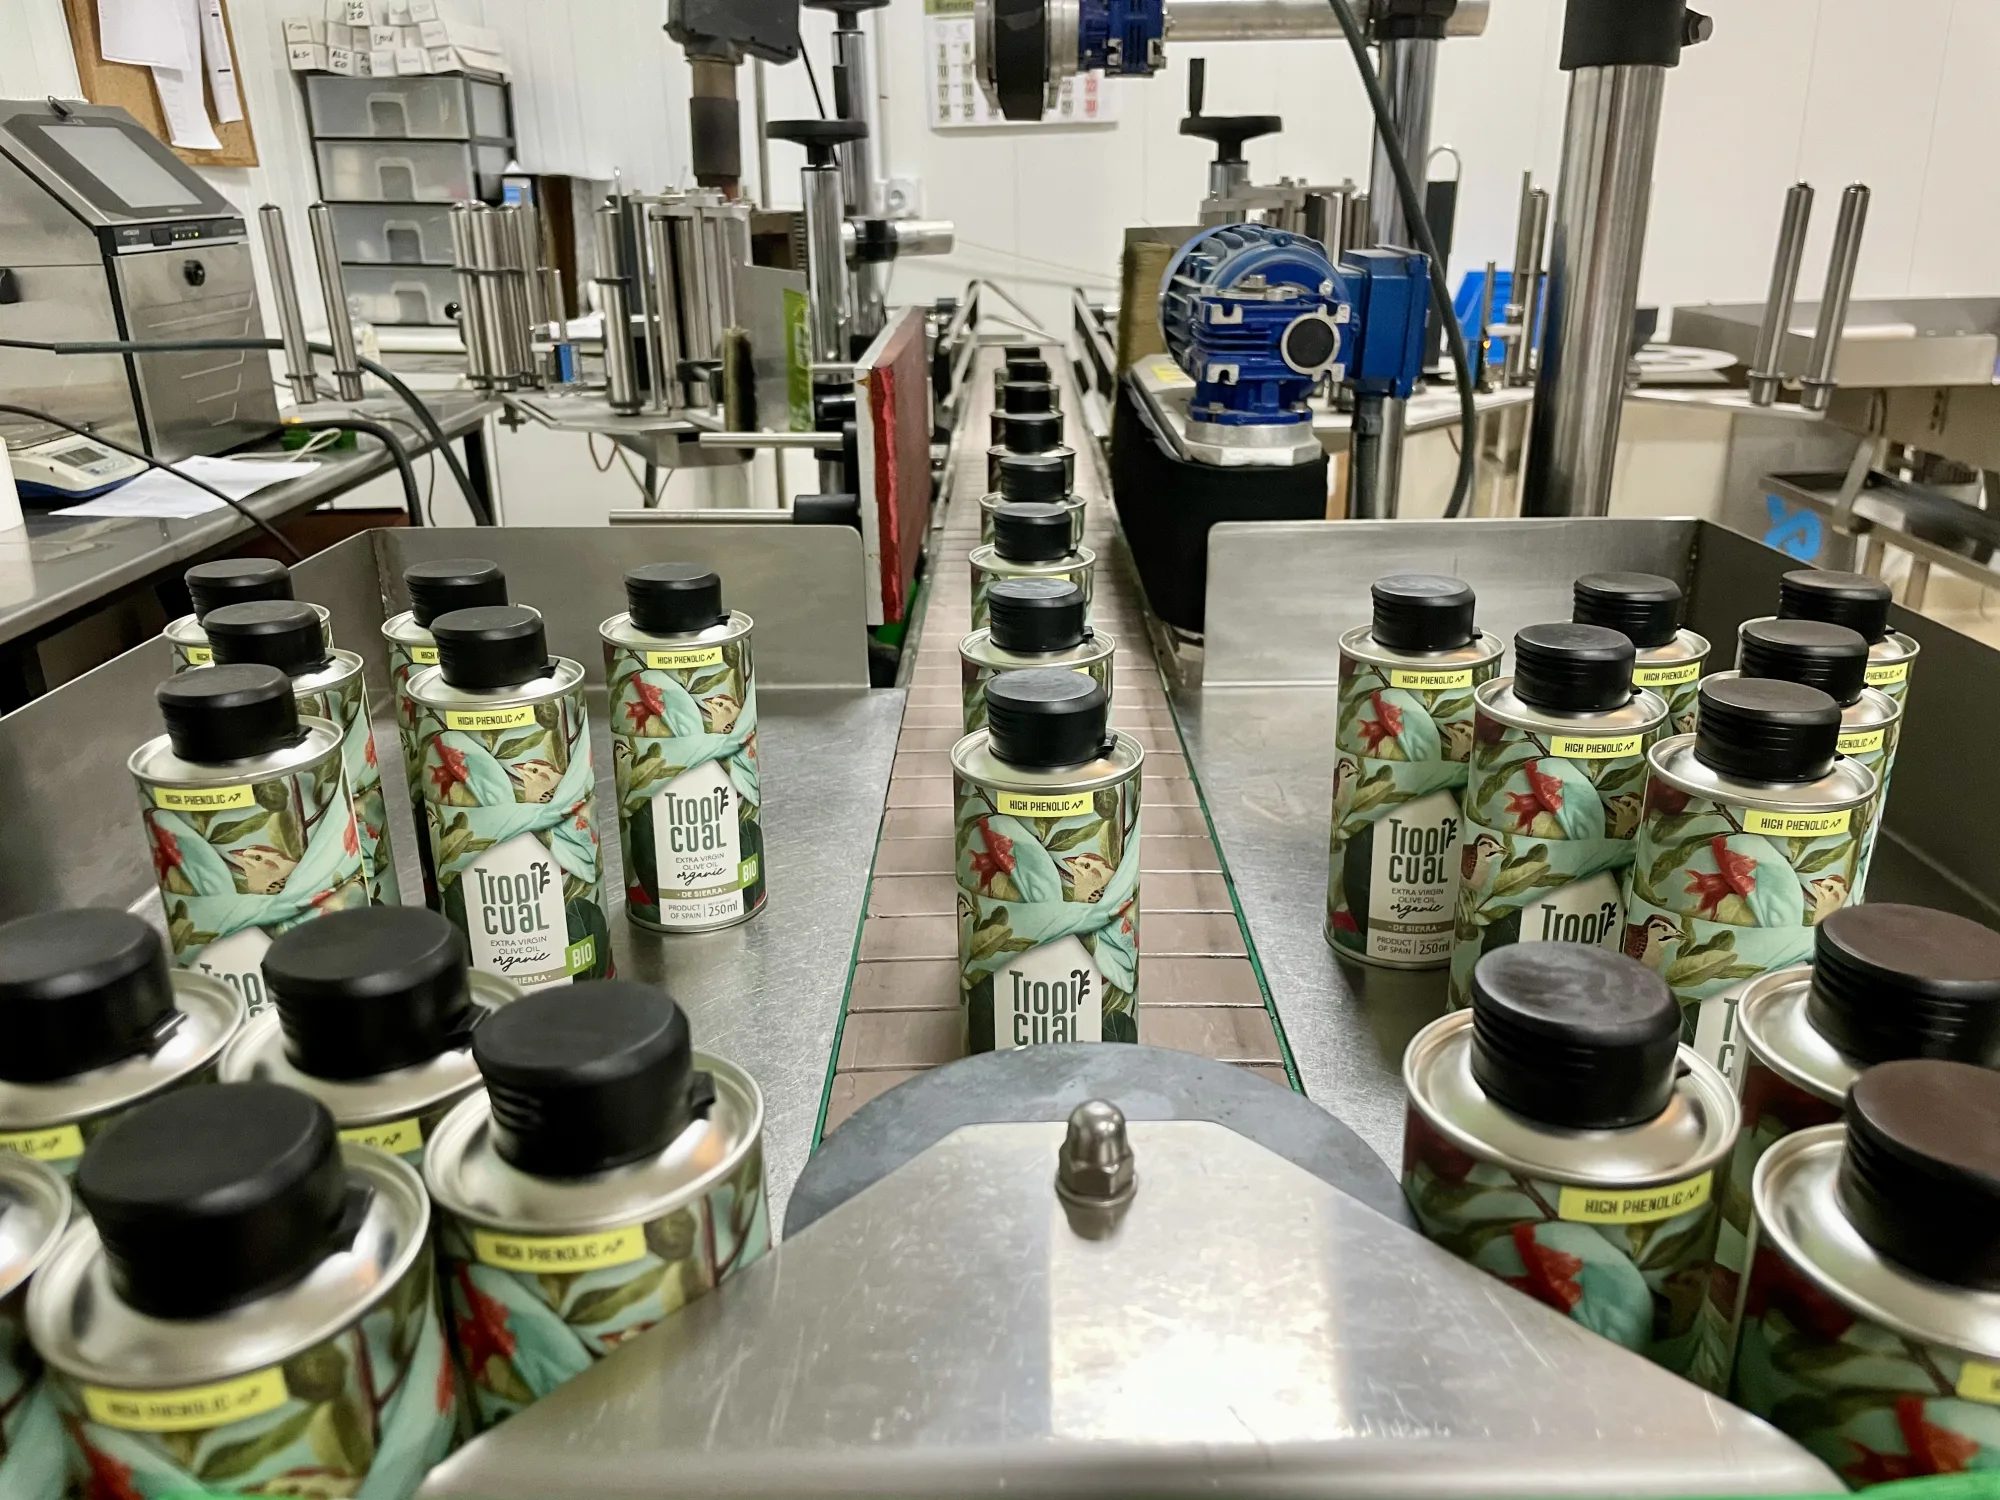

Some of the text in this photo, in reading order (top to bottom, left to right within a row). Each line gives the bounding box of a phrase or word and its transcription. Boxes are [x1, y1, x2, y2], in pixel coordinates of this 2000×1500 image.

[657, 654, 706, 665] HIGH PHENOLIC
[1402, 675, 1454, 685] HIGH PHENOLIC
[1643, 669, 1689, 682] HIGH PHENOLIC
[1865, 670, 1894, 681] PHENOLIC
[457, 714, 513, 725] HIGH PHENOLIC
[1564, 742, 1623, 753] HIGH PHENOLIC
[1838, 738, 1867, 749] HENOLIC
[183, 794, 226, 805] PHENOLIC
[665, 787, 729, 826] Tropi
[1009, 800, 1070, 812] HIGH PHENOLIC
[1760, 818, 1829, 831] HIGH PHENOLIC
[1389, 818, 1457, 856] Tropi
[675, 853, 725, 864] EXTRA VIRGIN
[682, 863, 705, 871] OLIVE
[743, 861, 757, 882] BIO
[676, 867, 727, 886] organic
[474, 862, 550, 906] Tropi
[694, 887, 722, 897] SIERRA
[1392, 888, 1444, 896] EXTRA VIRGIN
[1398, 896, 1437, 904] OLIVE OIL
[668, 903, 701, 911] PRODUCT
[708, 901, 738, 917] 250ml
[1390, 902, 1444, 919] organic
[681, 911, 702, 919] SPAIN
[1541, 902, 1617, 944] Tropi
[490, 936, 547, 948] EXTRA VIRGIN
[1376, 936, 1412, 946] PRODUCT
[498, 945, 540, 955] OLIVE OIL
[1389, 946, 1411, 955] SPAIN
[572, 943, 592, 969] BIO
[492, 951, 551, 973] organic
[1009, 969, 1091, 1017] Tropi
[1584, 1191, 1683, 1214] HIGH PHENOLIC
